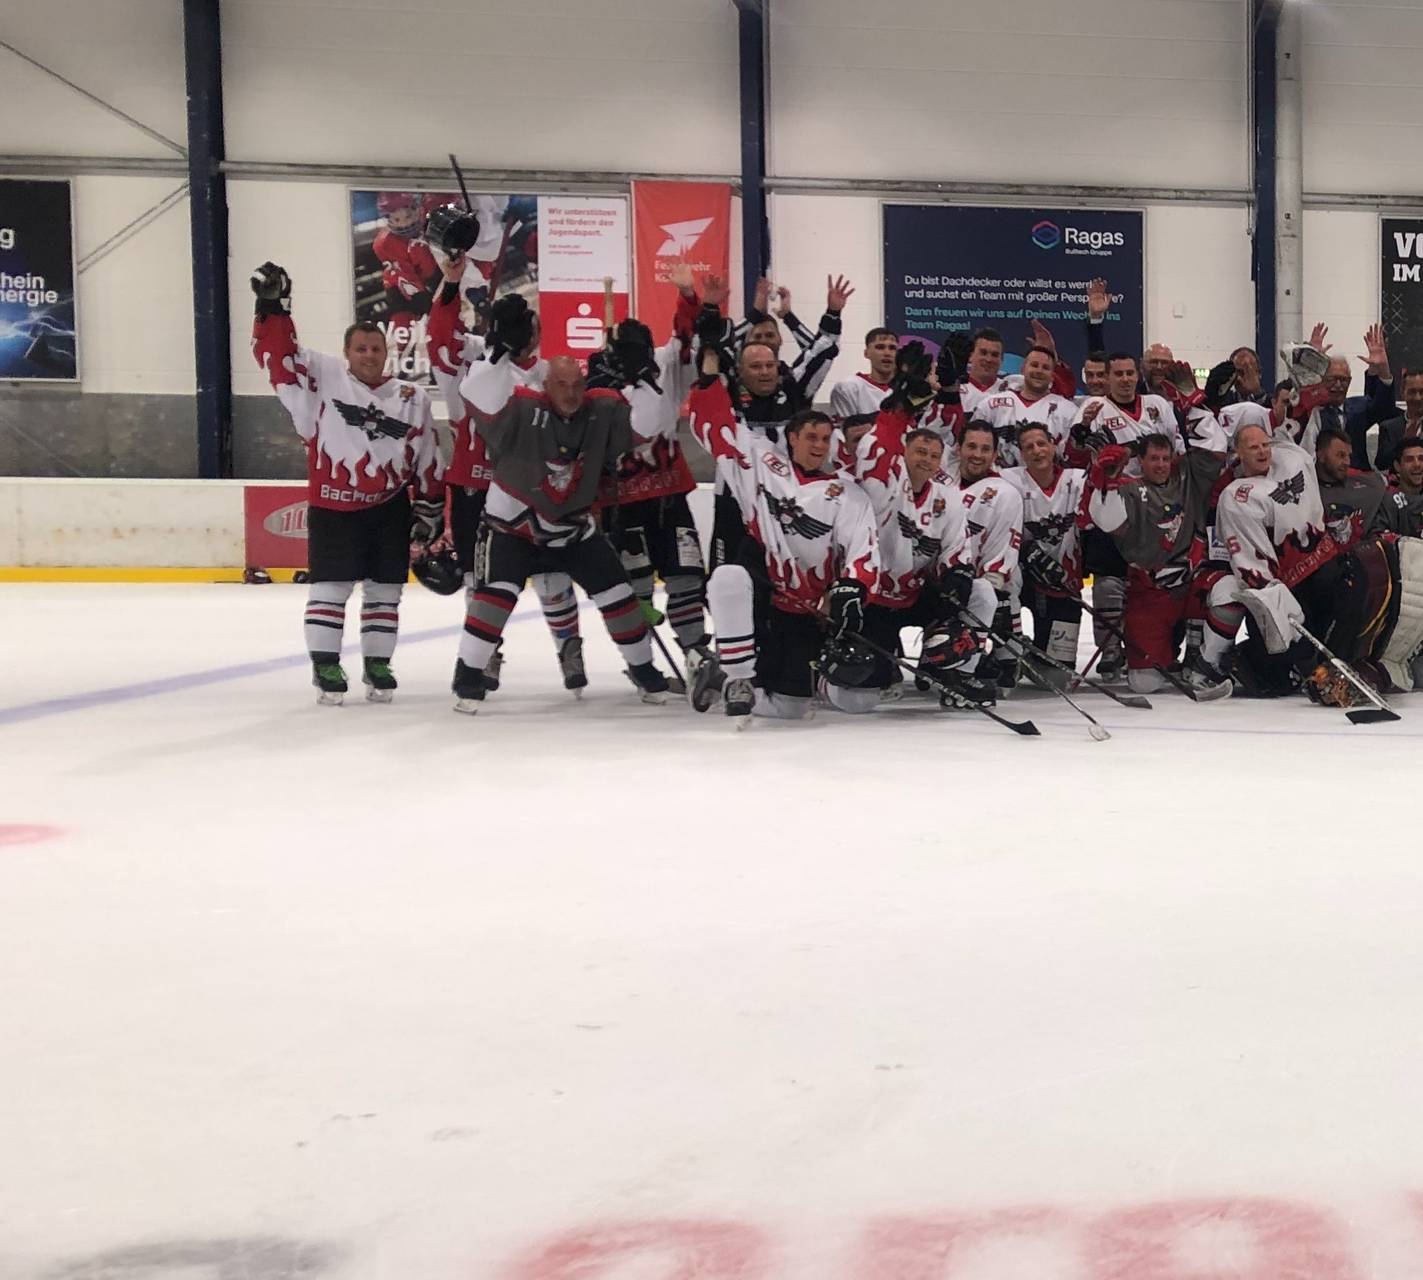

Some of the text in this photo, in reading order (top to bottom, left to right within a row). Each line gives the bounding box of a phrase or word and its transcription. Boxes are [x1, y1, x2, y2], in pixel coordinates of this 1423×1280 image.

[1065, 227, 1124, 249] Ragas
[0, 272, 44, 289] hein
[1393, 263, 1420, 282] IM
[904, 275, 920, 286] Du
[921, 276, 939, 287] bist
[941, 276, 1001, 288] Dachdecker
[1003, 278, 1026, 289] oder
[1028, 279, 1052, 289] willst
[1054, 281, 1067, 289] es
[904, 289, 924, 298] und
[926, 290, 958, 300] suchst
[961, 290, 976, 299] ein
[979, 291, 1006, 300] Team
[1008, 291, 1024, 301] mit
[1026, 292, 1059, 304] großer
[905, 306, 932, 316] Dann
[934, 307, 967, 317] freuen
[969, 308, 984, 317] wir
[986, 310, 1004, 318] uns
[1007, 309, 1024, 318] auf
[1026, 309, 1060, 320] Deinen
[906, 319, 971, 332] Team Ragas!
[531, 408, 550, 429] 11
